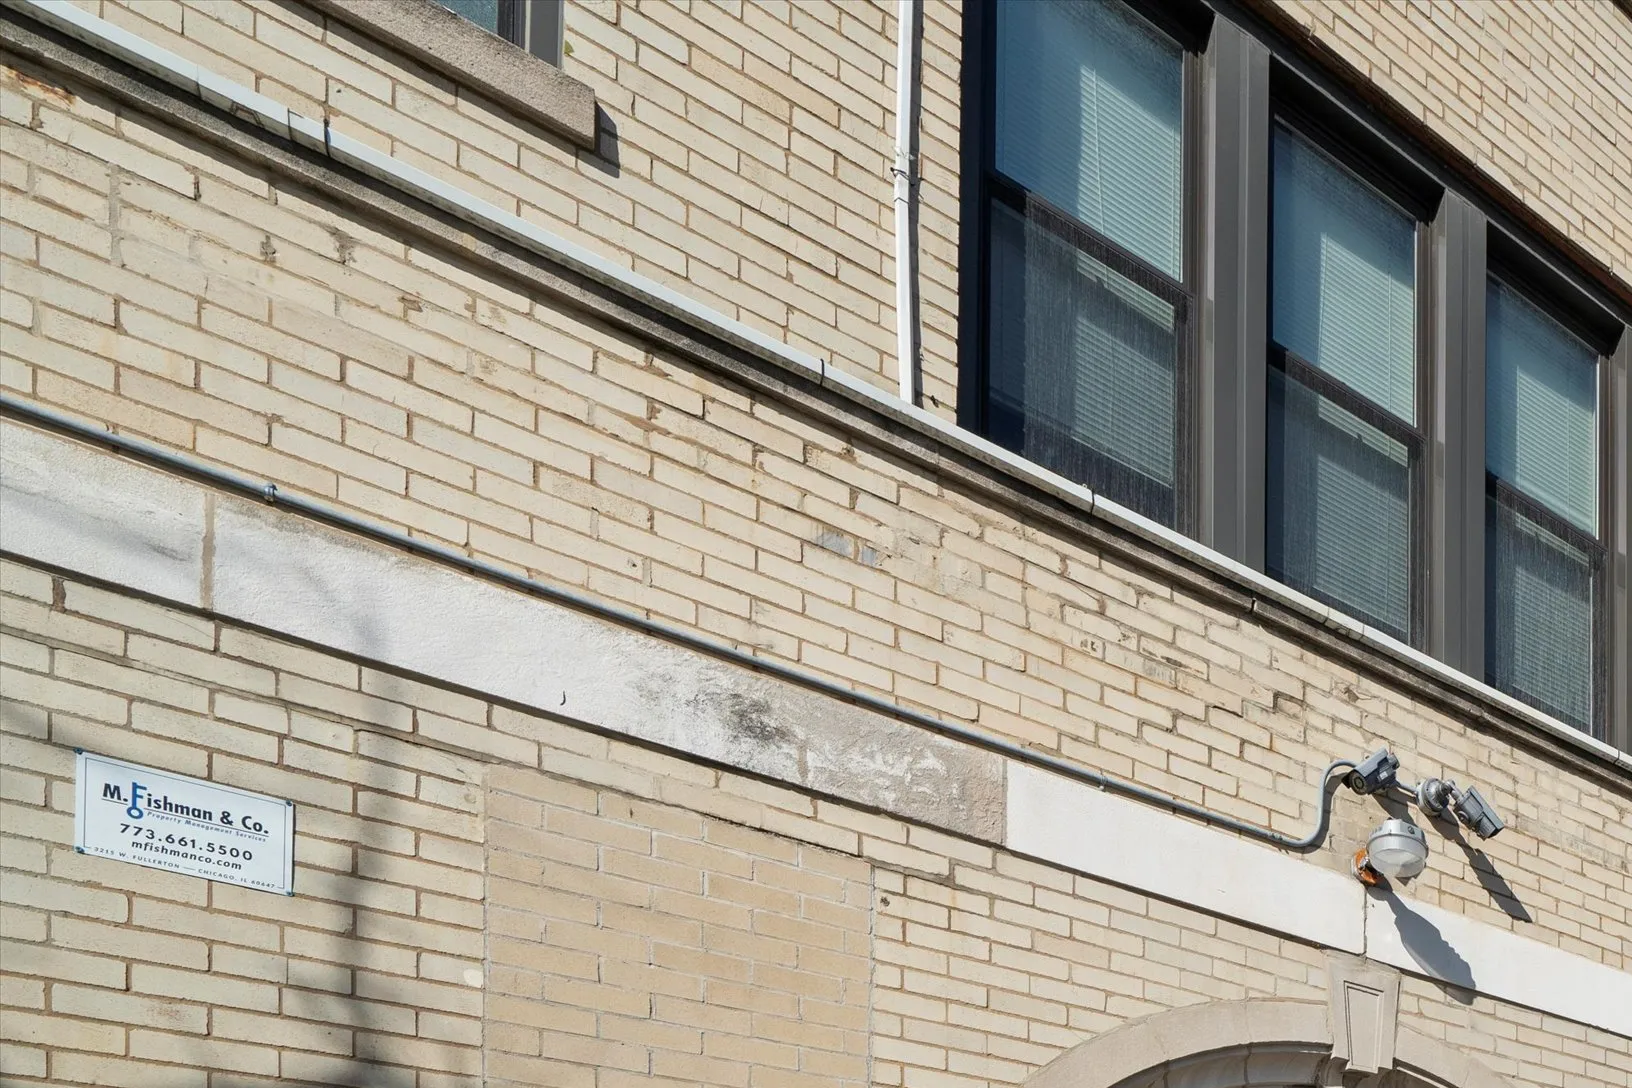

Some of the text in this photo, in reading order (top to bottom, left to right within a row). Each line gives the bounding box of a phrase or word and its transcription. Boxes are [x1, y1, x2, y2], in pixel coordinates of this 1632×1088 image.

[147, 811, 266, 842] Property Management Services
[219, 811, 234, 826] &
[241, 816, 269, 834] Co.
[120, 823, 253, 860] 773.661.5500
[131, 841, 242, 870] mfishmanco.com
[132, 855, 180, 868] FULLERTON
